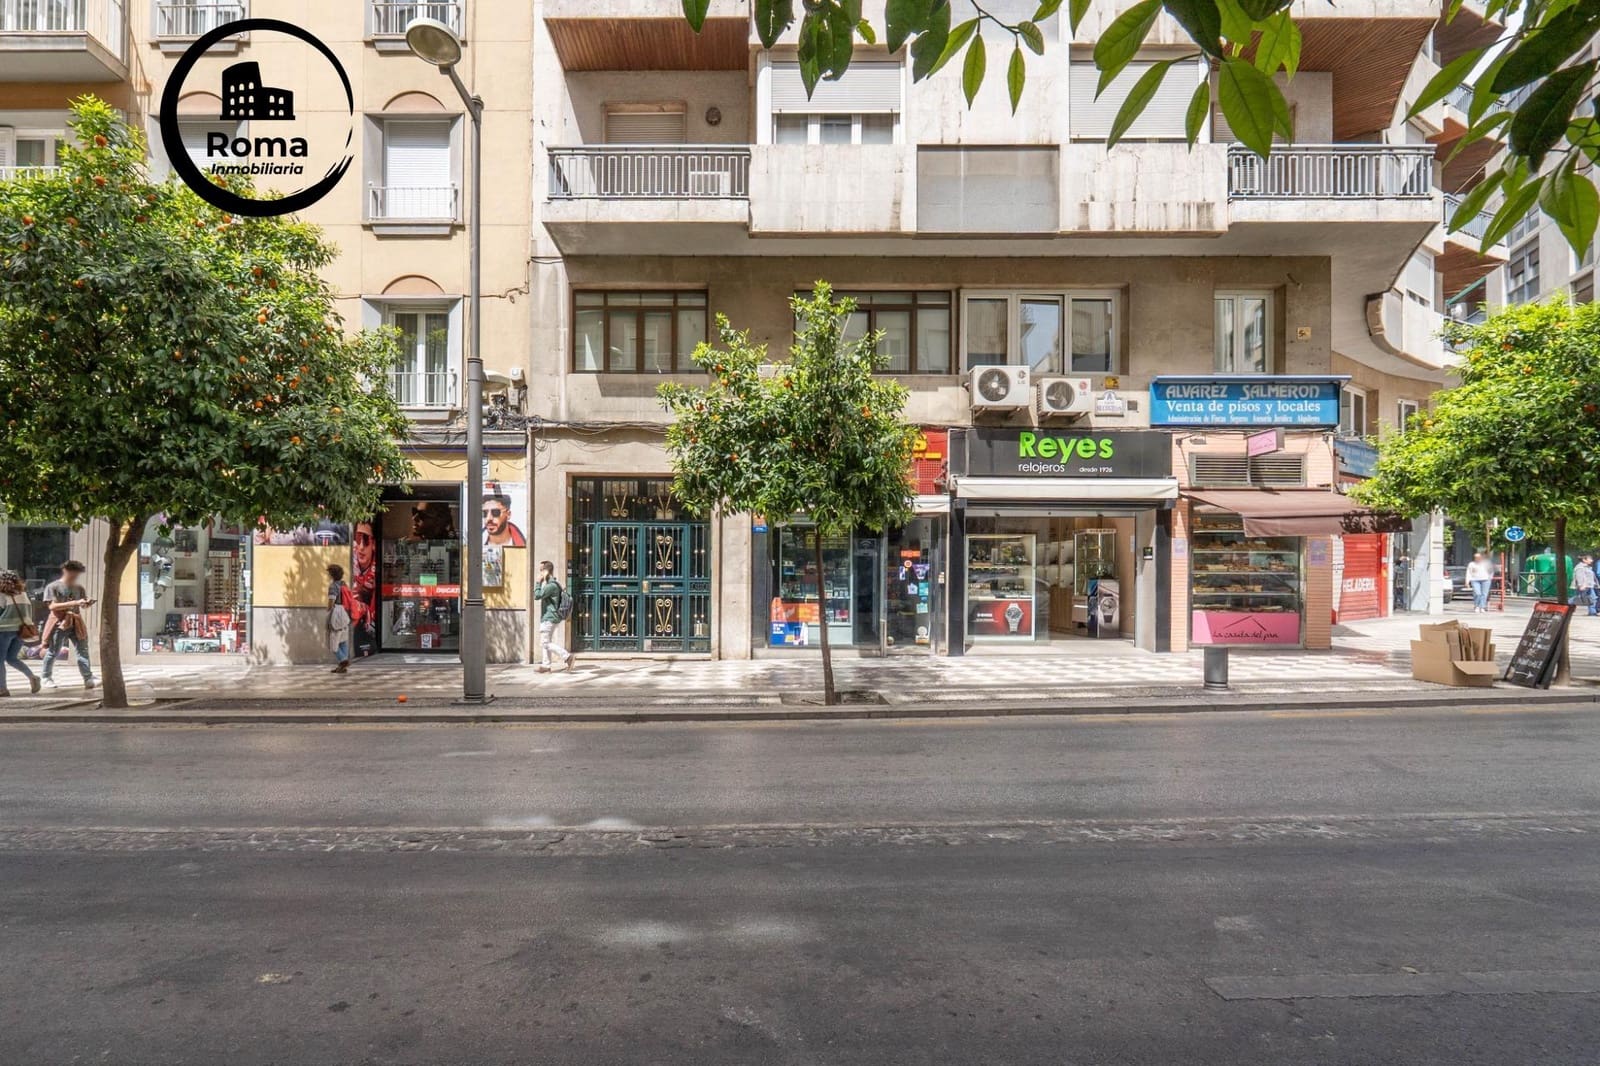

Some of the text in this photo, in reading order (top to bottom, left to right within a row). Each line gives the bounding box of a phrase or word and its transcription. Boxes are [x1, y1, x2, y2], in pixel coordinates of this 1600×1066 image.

[1166, 385, 1320, 400] ALVAREZ SALMERON
[1166, 400, 1321, 414] Venta de pisos y locales
[1019, 431, 1114, 464] Reyes
[1018, 462, 1065, 473] relojeros
